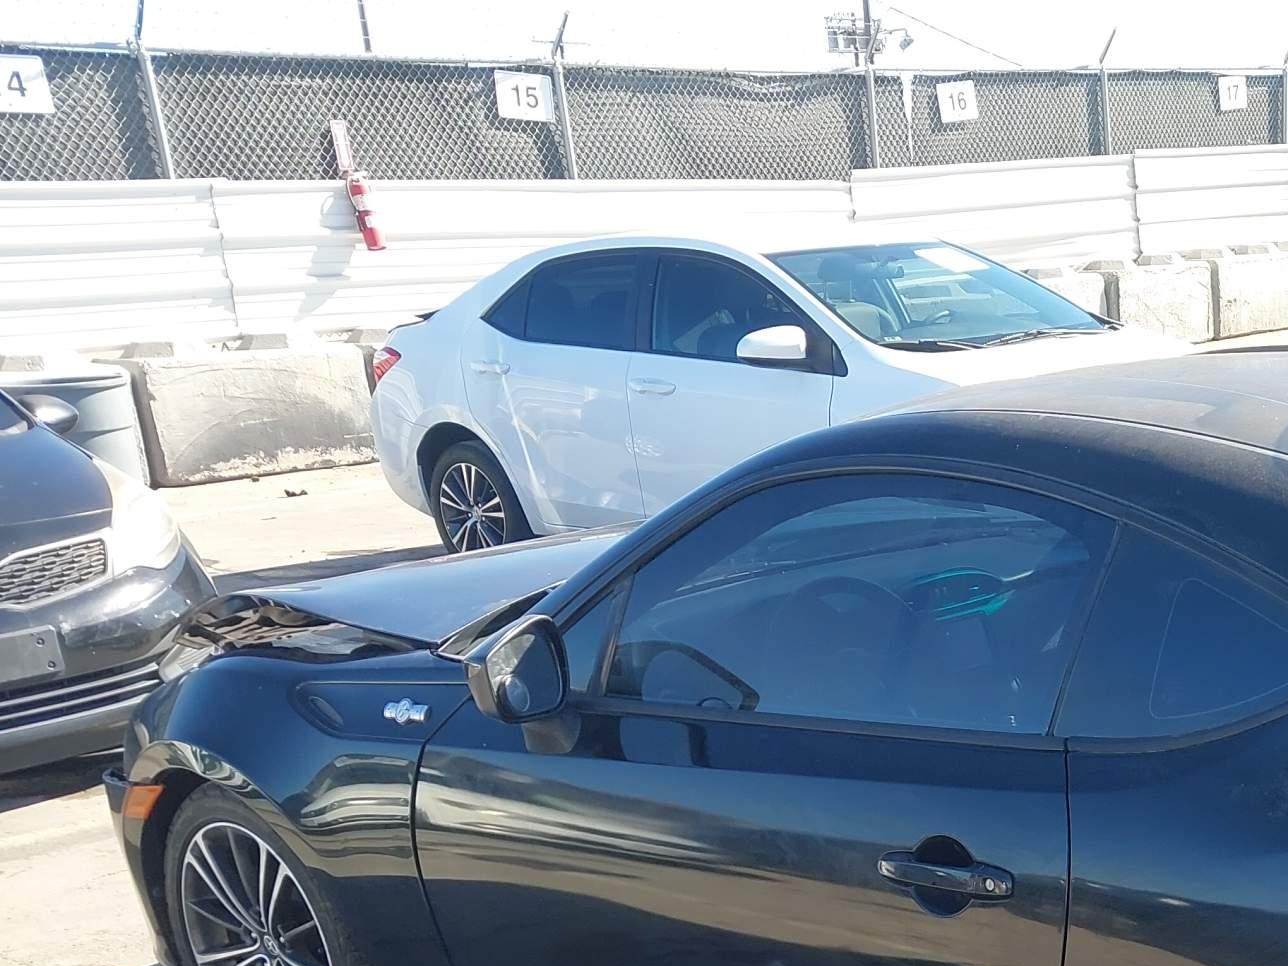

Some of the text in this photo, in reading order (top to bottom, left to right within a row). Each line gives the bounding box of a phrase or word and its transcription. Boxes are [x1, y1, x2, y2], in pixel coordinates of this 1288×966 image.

[0, 71, 27, 97] 4
[1227, 84, 1239, 101] 17
[511, 84, 539, 109] 15
[949, 91, 967, 111] 16
